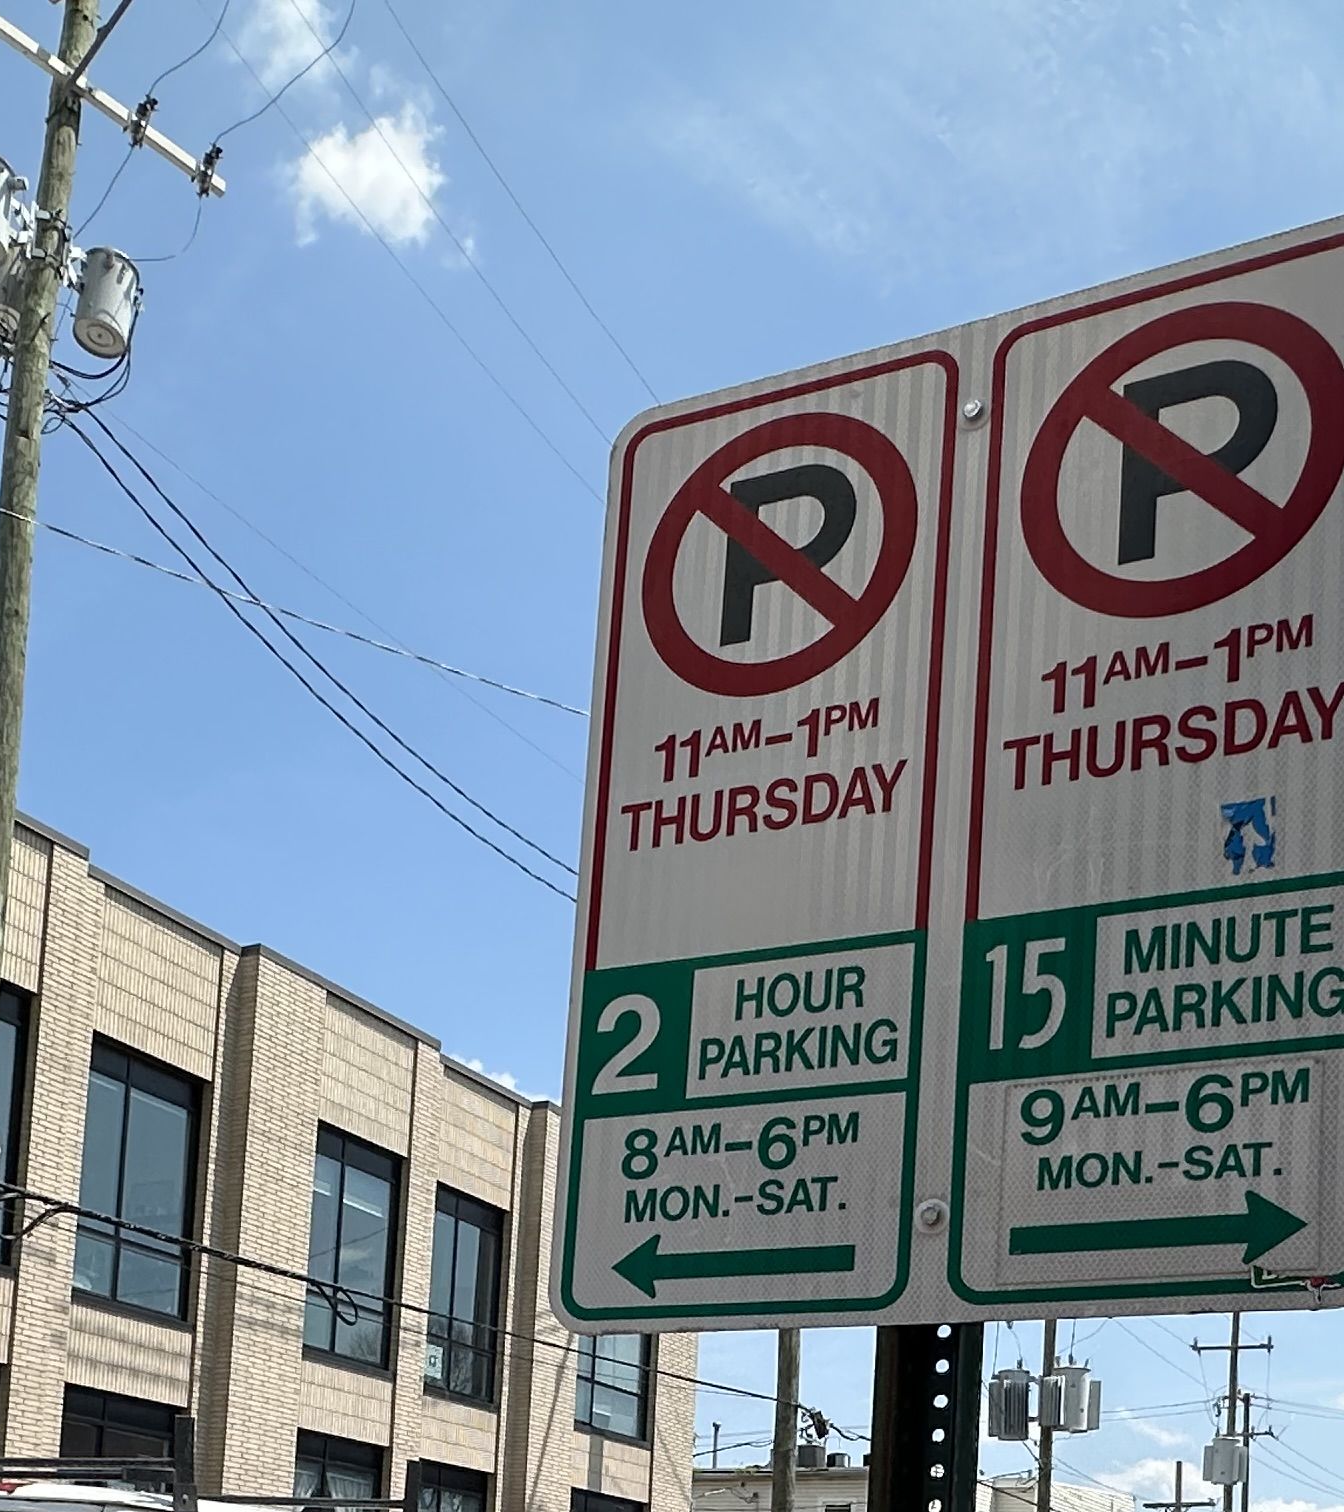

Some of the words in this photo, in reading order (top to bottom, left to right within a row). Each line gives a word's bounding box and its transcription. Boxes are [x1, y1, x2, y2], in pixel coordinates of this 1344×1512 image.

[620, 758, 908, 853] THURSDAY
[1123, 904, 1335, 976] MINUTE
[733, 964, 867, 1022] HOUR
[982, 937, 1067, 1051] 15
[591, 994, 662, 1096] 2
[697, 1018, 899, 1082] PARKING
